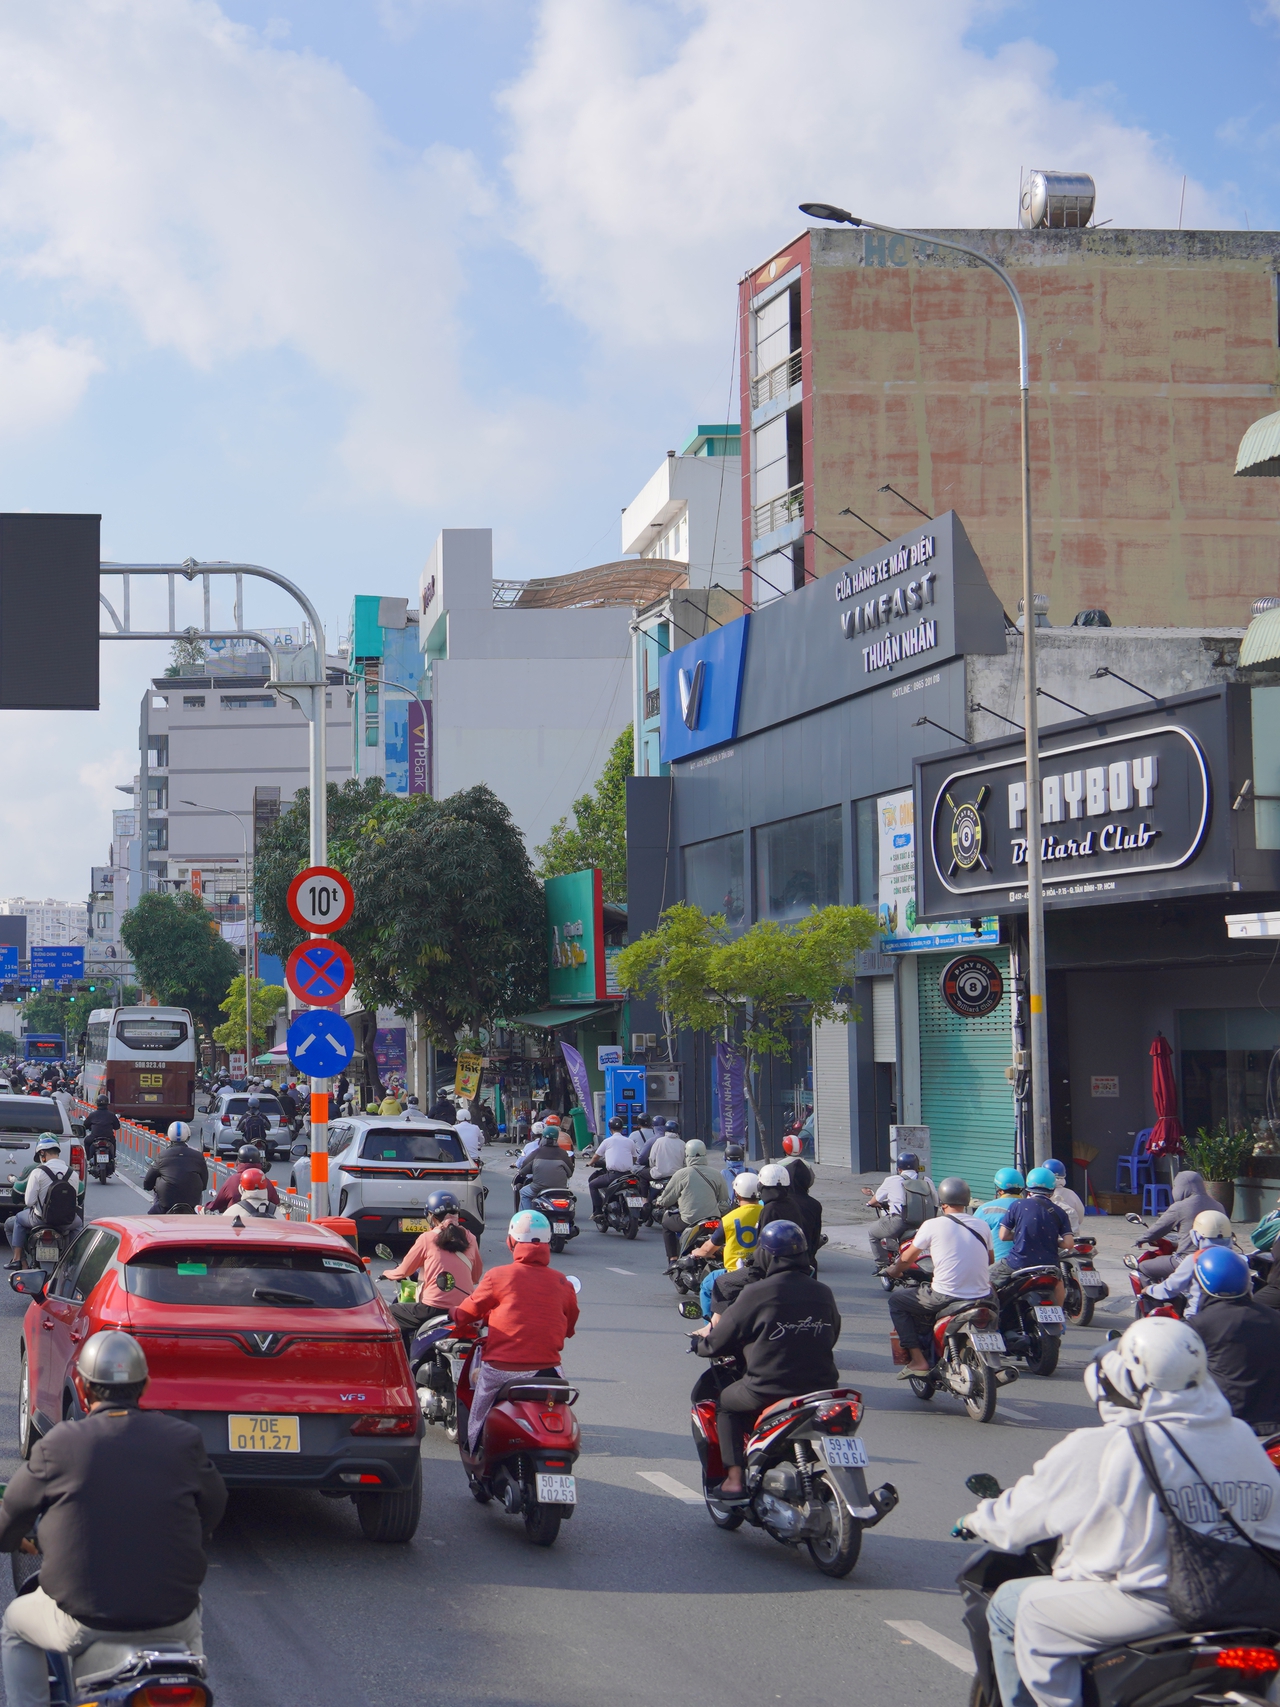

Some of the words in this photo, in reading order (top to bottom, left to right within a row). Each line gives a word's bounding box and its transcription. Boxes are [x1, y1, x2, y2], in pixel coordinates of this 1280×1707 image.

[835, 571, 852, 601] CỬA
[852, 567, 876, 592] HÀNG
[876, 561, 889, 583] XE
[890, 544, 911, 576] MÁY
[911, 535, 935, 566] ĐIỆN
[841, 571, 937, 639] VINFAST
[862, 631, 902, 673] THUẬN
[902, 617, 938, 661] NHÂN
[892, 684, 913, 699] HOTLINE:
[414, 742, 427, 787] TPBank
[1008, 755, 1158, 829] PAYBOY
[1010, 831, 1095, 865] Biliard
[1099, 823, 1158, 852] Club
[954, 962, 975, 976] PLAY
[976, 963, 992, 976] BOY
[969, 982, 978, 992] 8
[956, 1000, 980, 1013] Billiard
[980, 999, 993, 1011] Club
[140, 1074, 163, 1085] SG
[722, 1073, 732, 1102] NHÂN
[723, 1104, 735, 1138] THUẬN
[249, 1418, 279, 1433] 70E
[238, 1434, 292, 1450] 011.27
[829, 1437, 858, 1451] 59-N1
[829, 1451, 866, 1465] 619.64
[541, 1475, 571, 1489] 50-AC
[541, 1489, 575, 1502] 402.53
